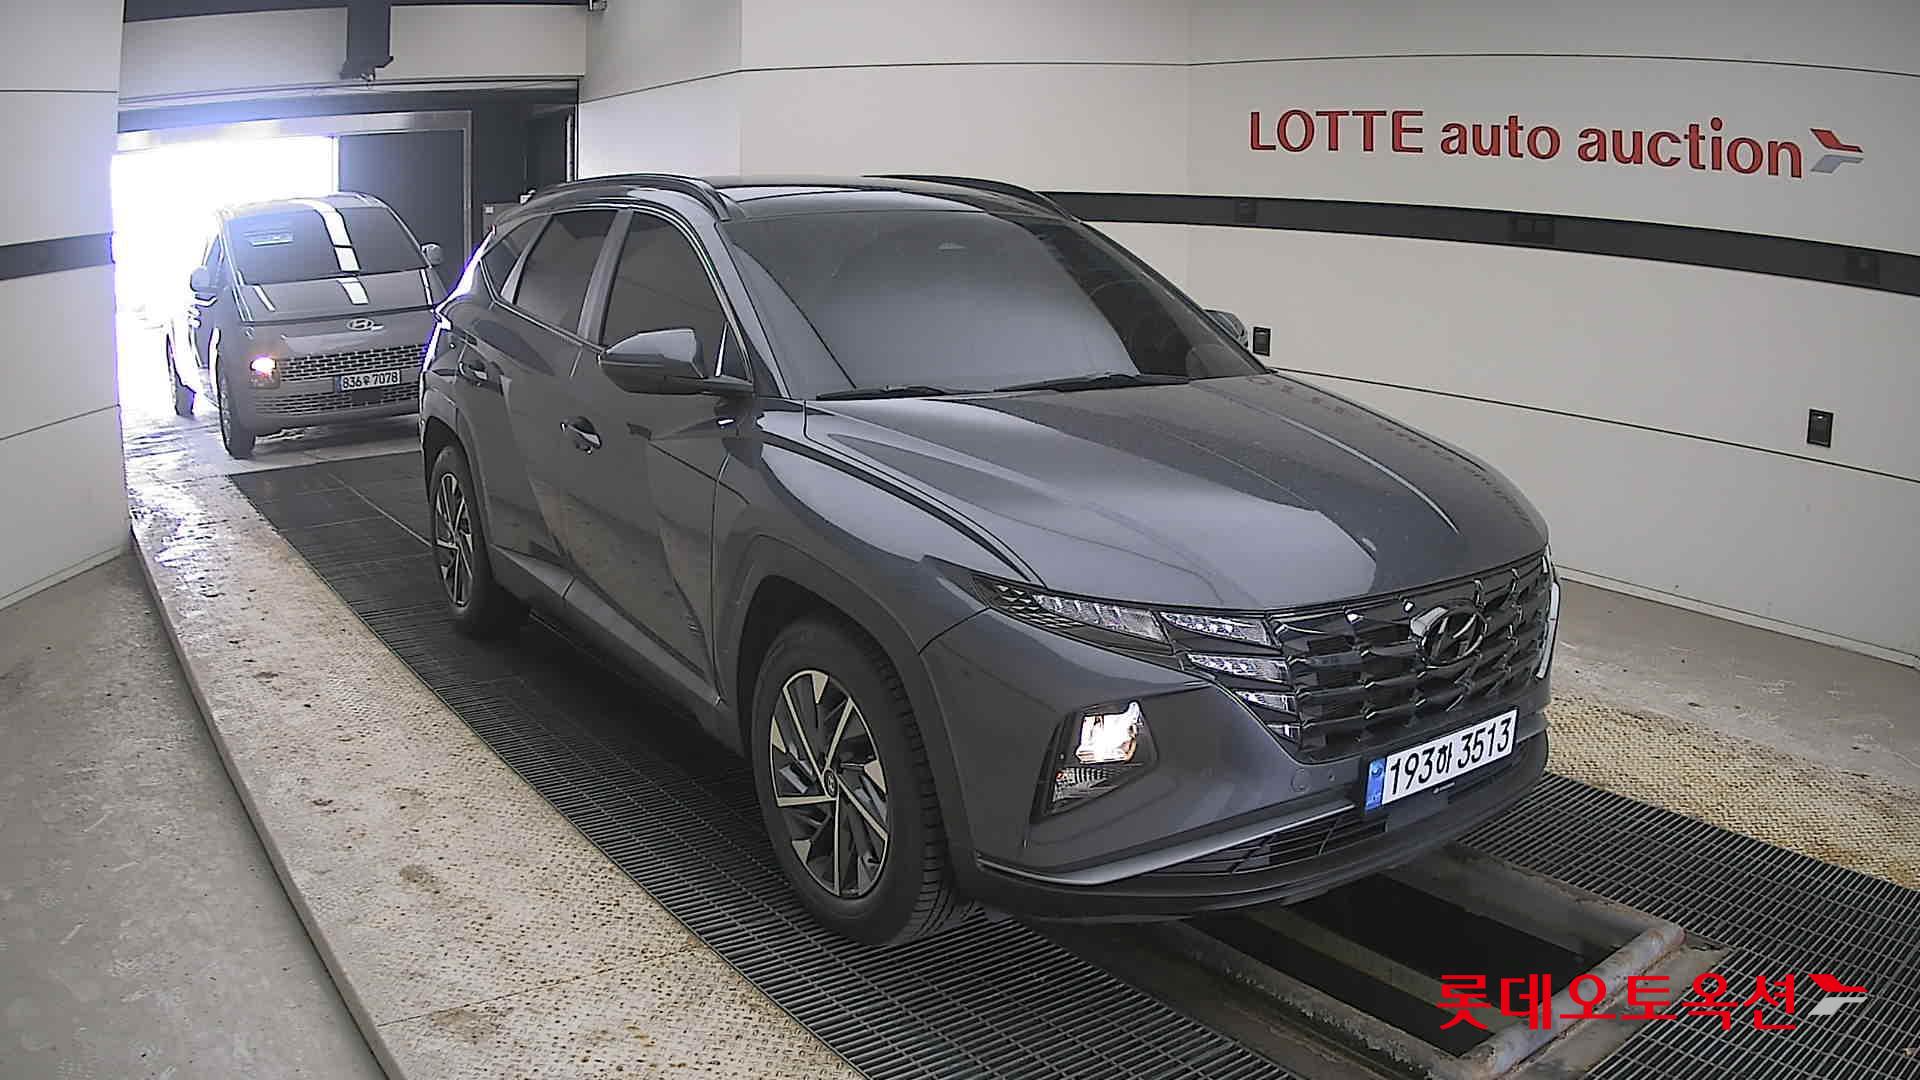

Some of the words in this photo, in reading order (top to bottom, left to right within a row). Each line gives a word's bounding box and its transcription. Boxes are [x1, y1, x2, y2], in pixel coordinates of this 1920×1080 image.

[1250, 109, 1423, 153] LOTTE
[1440, 115, 1561, 159] auto
[1577, 117, 1802, 178] auction
[372, 371, 398, 385] 7078
[1390, 742, 1453, 795] 193하
[1457, 717, 1512, 768] 3513
